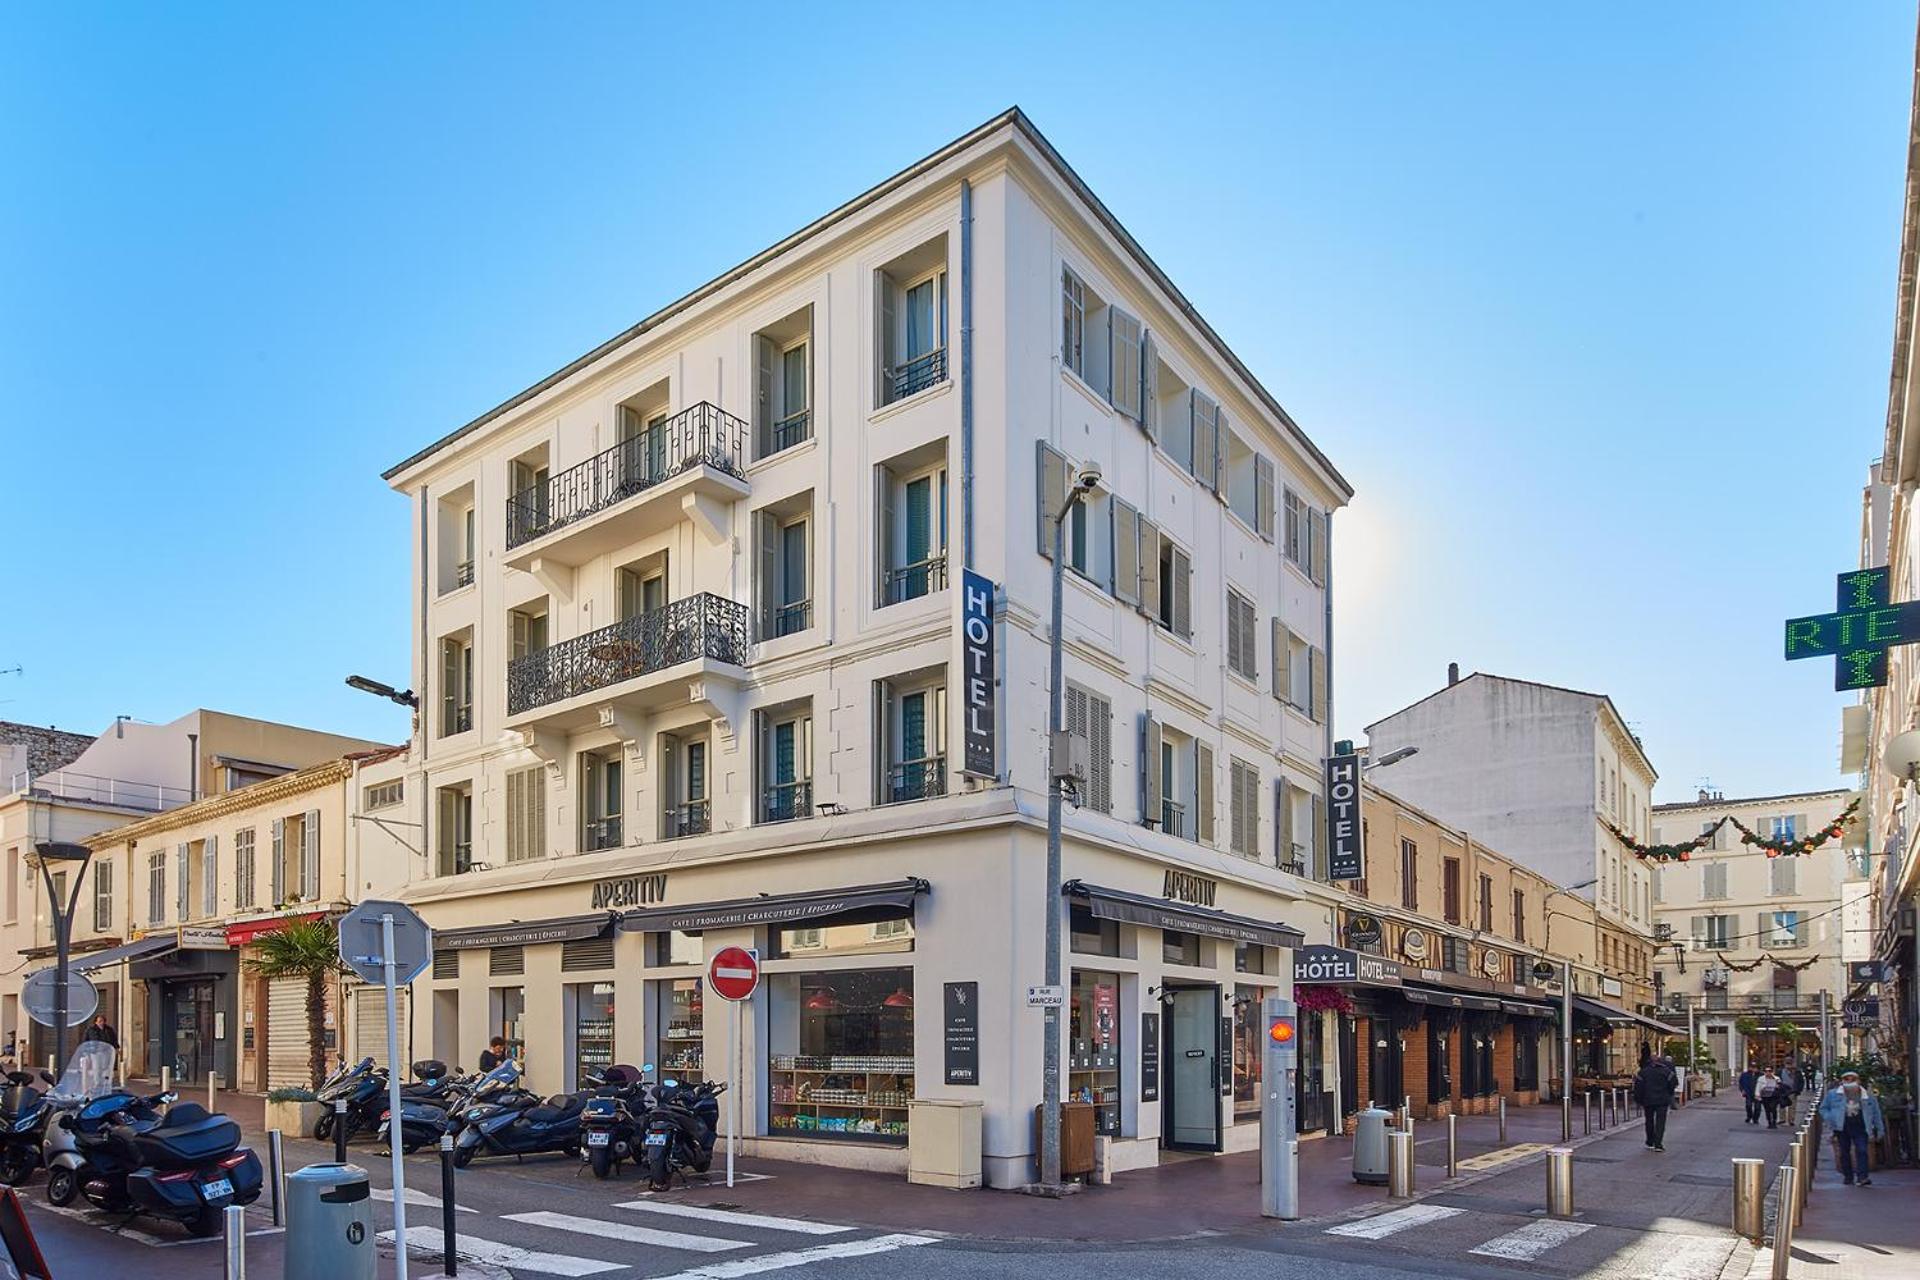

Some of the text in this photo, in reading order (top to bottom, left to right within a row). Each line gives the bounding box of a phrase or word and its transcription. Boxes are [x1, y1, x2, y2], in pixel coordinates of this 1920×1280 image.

[966, 585, 989, 736] HOTEL
[1331, 764, 1354, 856] HOTEL
[591, 874, 668, 909] APERITIV
[1162, 869, 1217, 907] APERITIV
[748, 908, 800, 920] CHARCUTERIE
[1295, 962, 1356, 979] HOTEL
[1360, 959, 1384, 980] HOTEL
